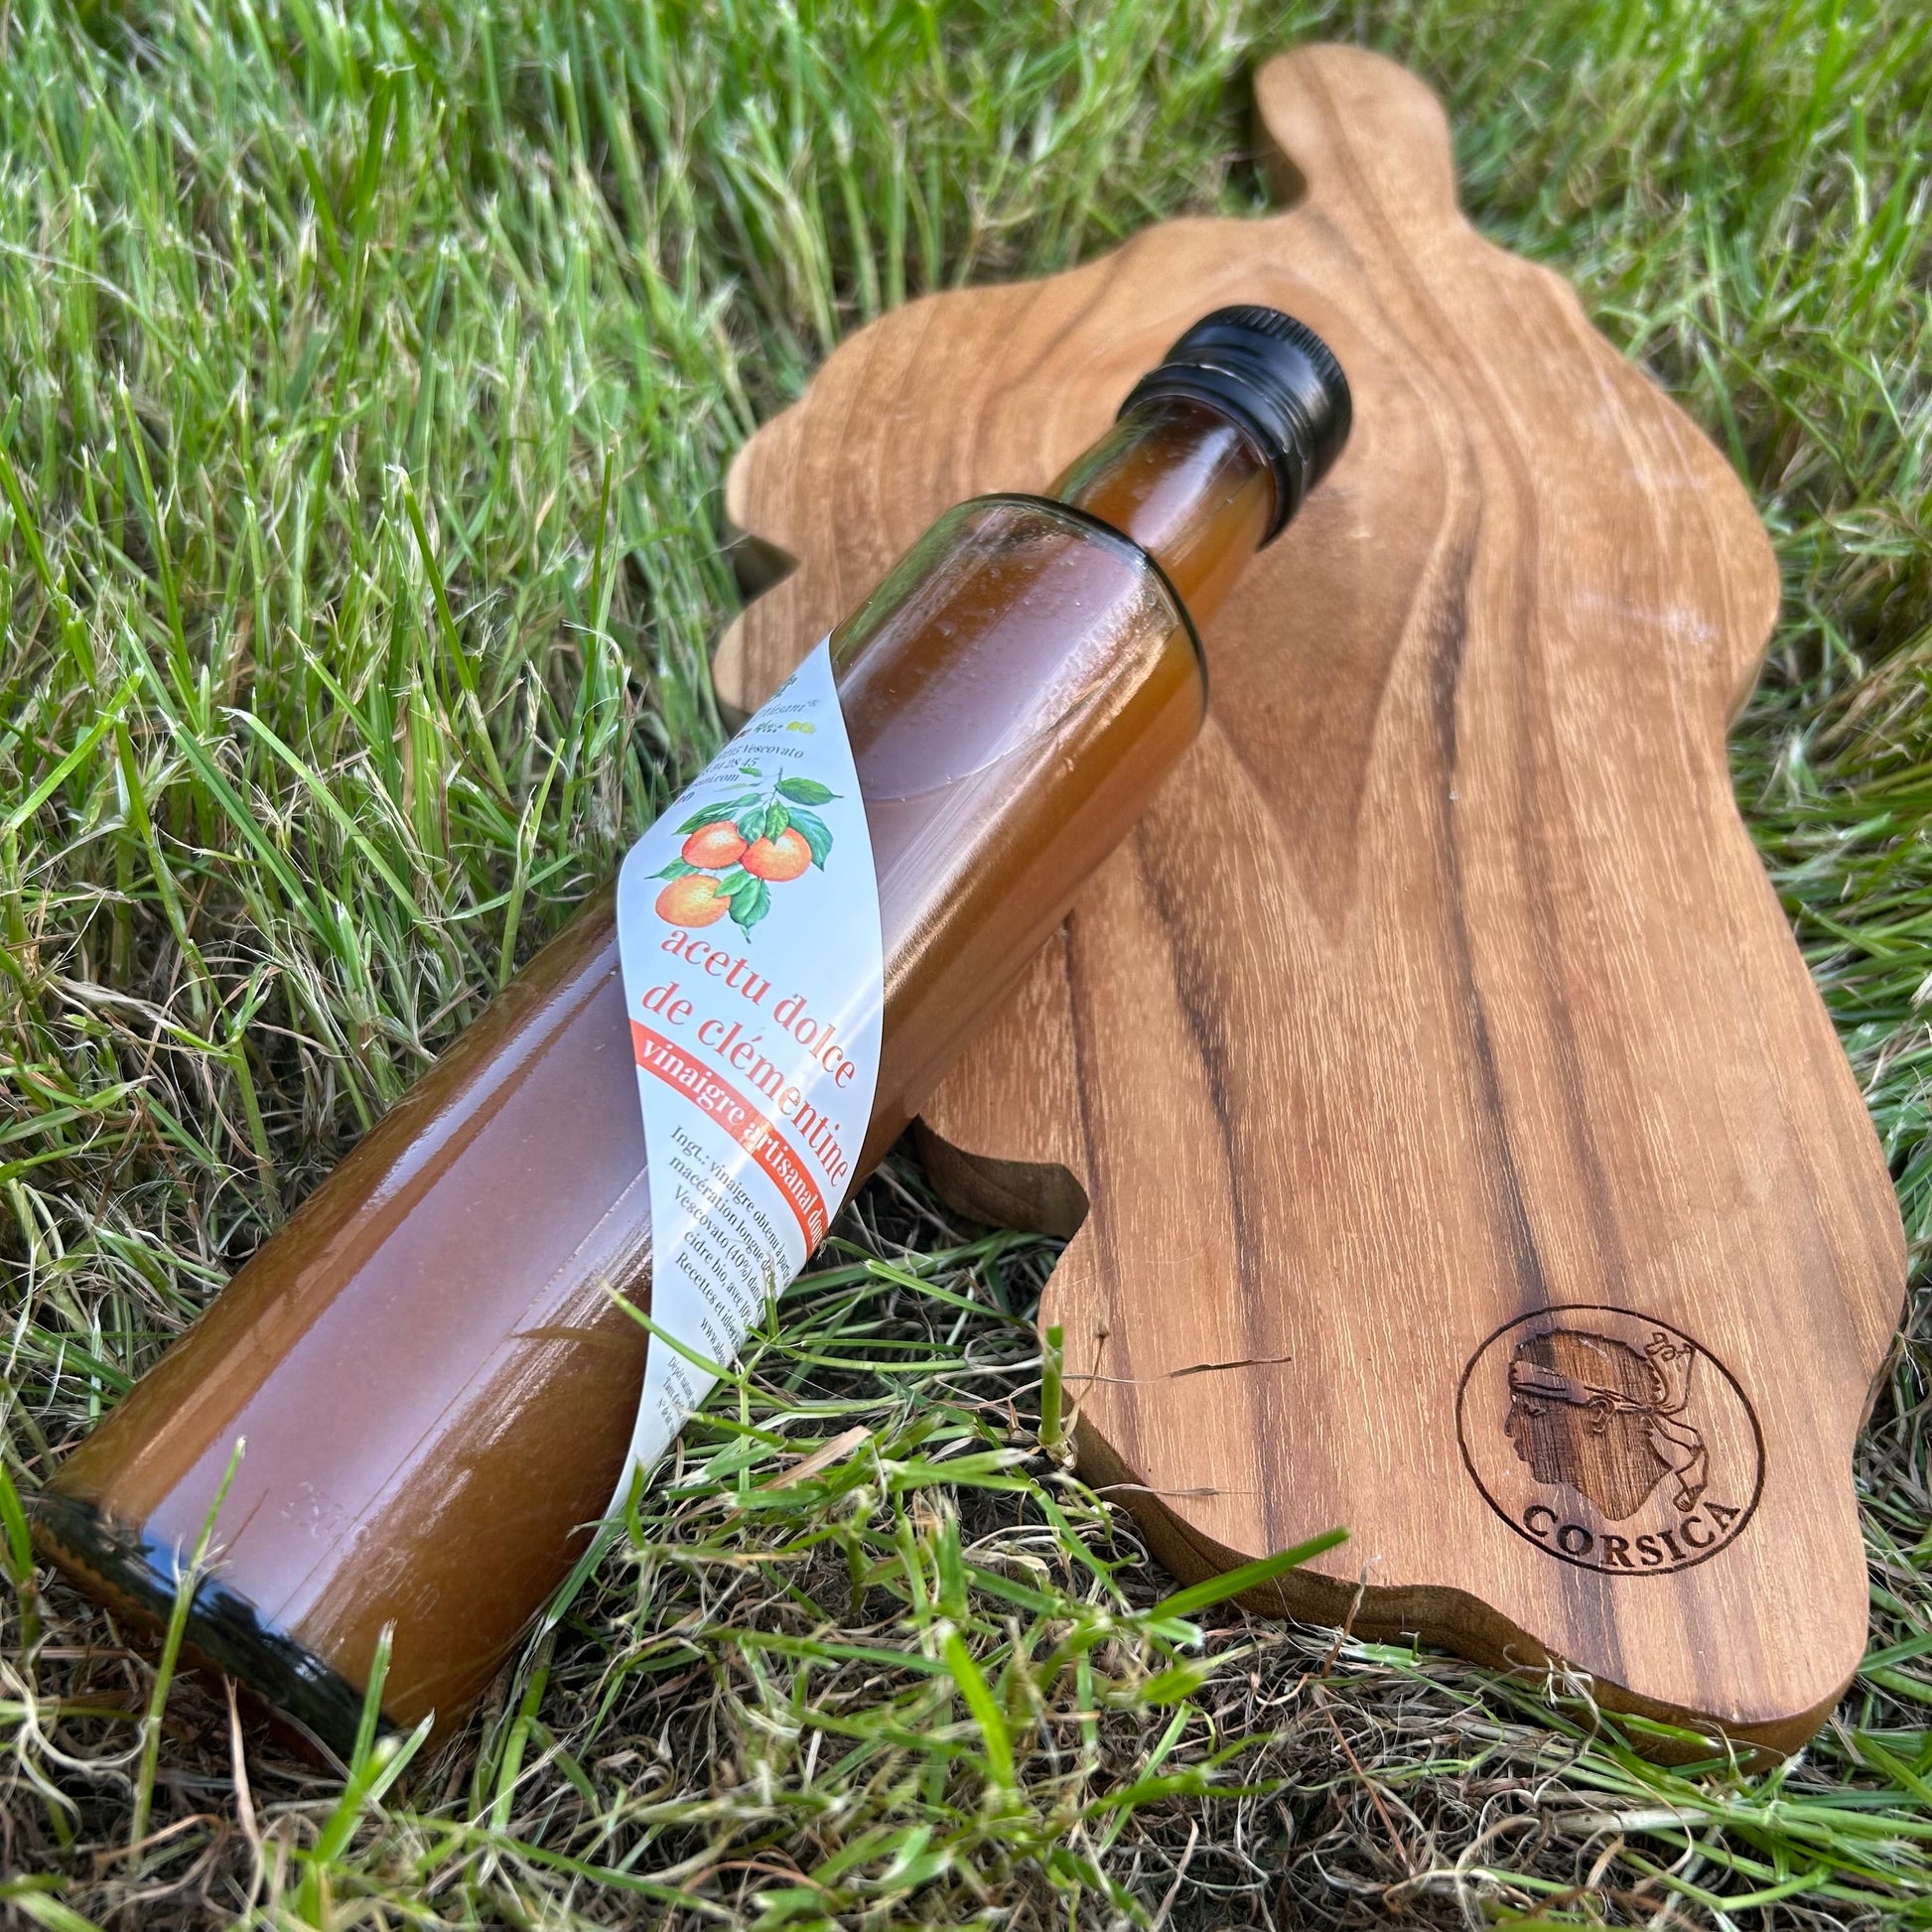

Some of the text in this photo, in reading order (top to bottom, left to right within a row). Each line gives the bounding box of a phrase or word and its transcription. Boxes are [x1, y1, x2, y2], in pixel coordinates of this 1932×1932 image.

[743, 745, 804, 759] Vescovato
[660, 929, 856, 1088] acetu dolce
[641, 981, 849, 1187] de clémentine
[642, 1038, 746, 1124] vinaigre
[743, 1122, 819, 1216] artisanal
[669, 1157, 737, 1227] macération
[736, 1219, 764, 1263] longue
[674, 1183, 730, 1248] Vescovato
[725, 1244, 753, 1283] (40%)
[711, 1160, 755, 1211] vinaigre
[754, 1210, 779, 1250] obtenu
[675, 1252, 720, 1305] Recettes
[715, 1302, 726, 1317] et
[684, 1230, 716, 1264] cidre
[711, 1254, 728, 1287] bio,
[727, 1282, 744, 1308] avec
[1523, 1501, 1741, 1568] CORSICA
